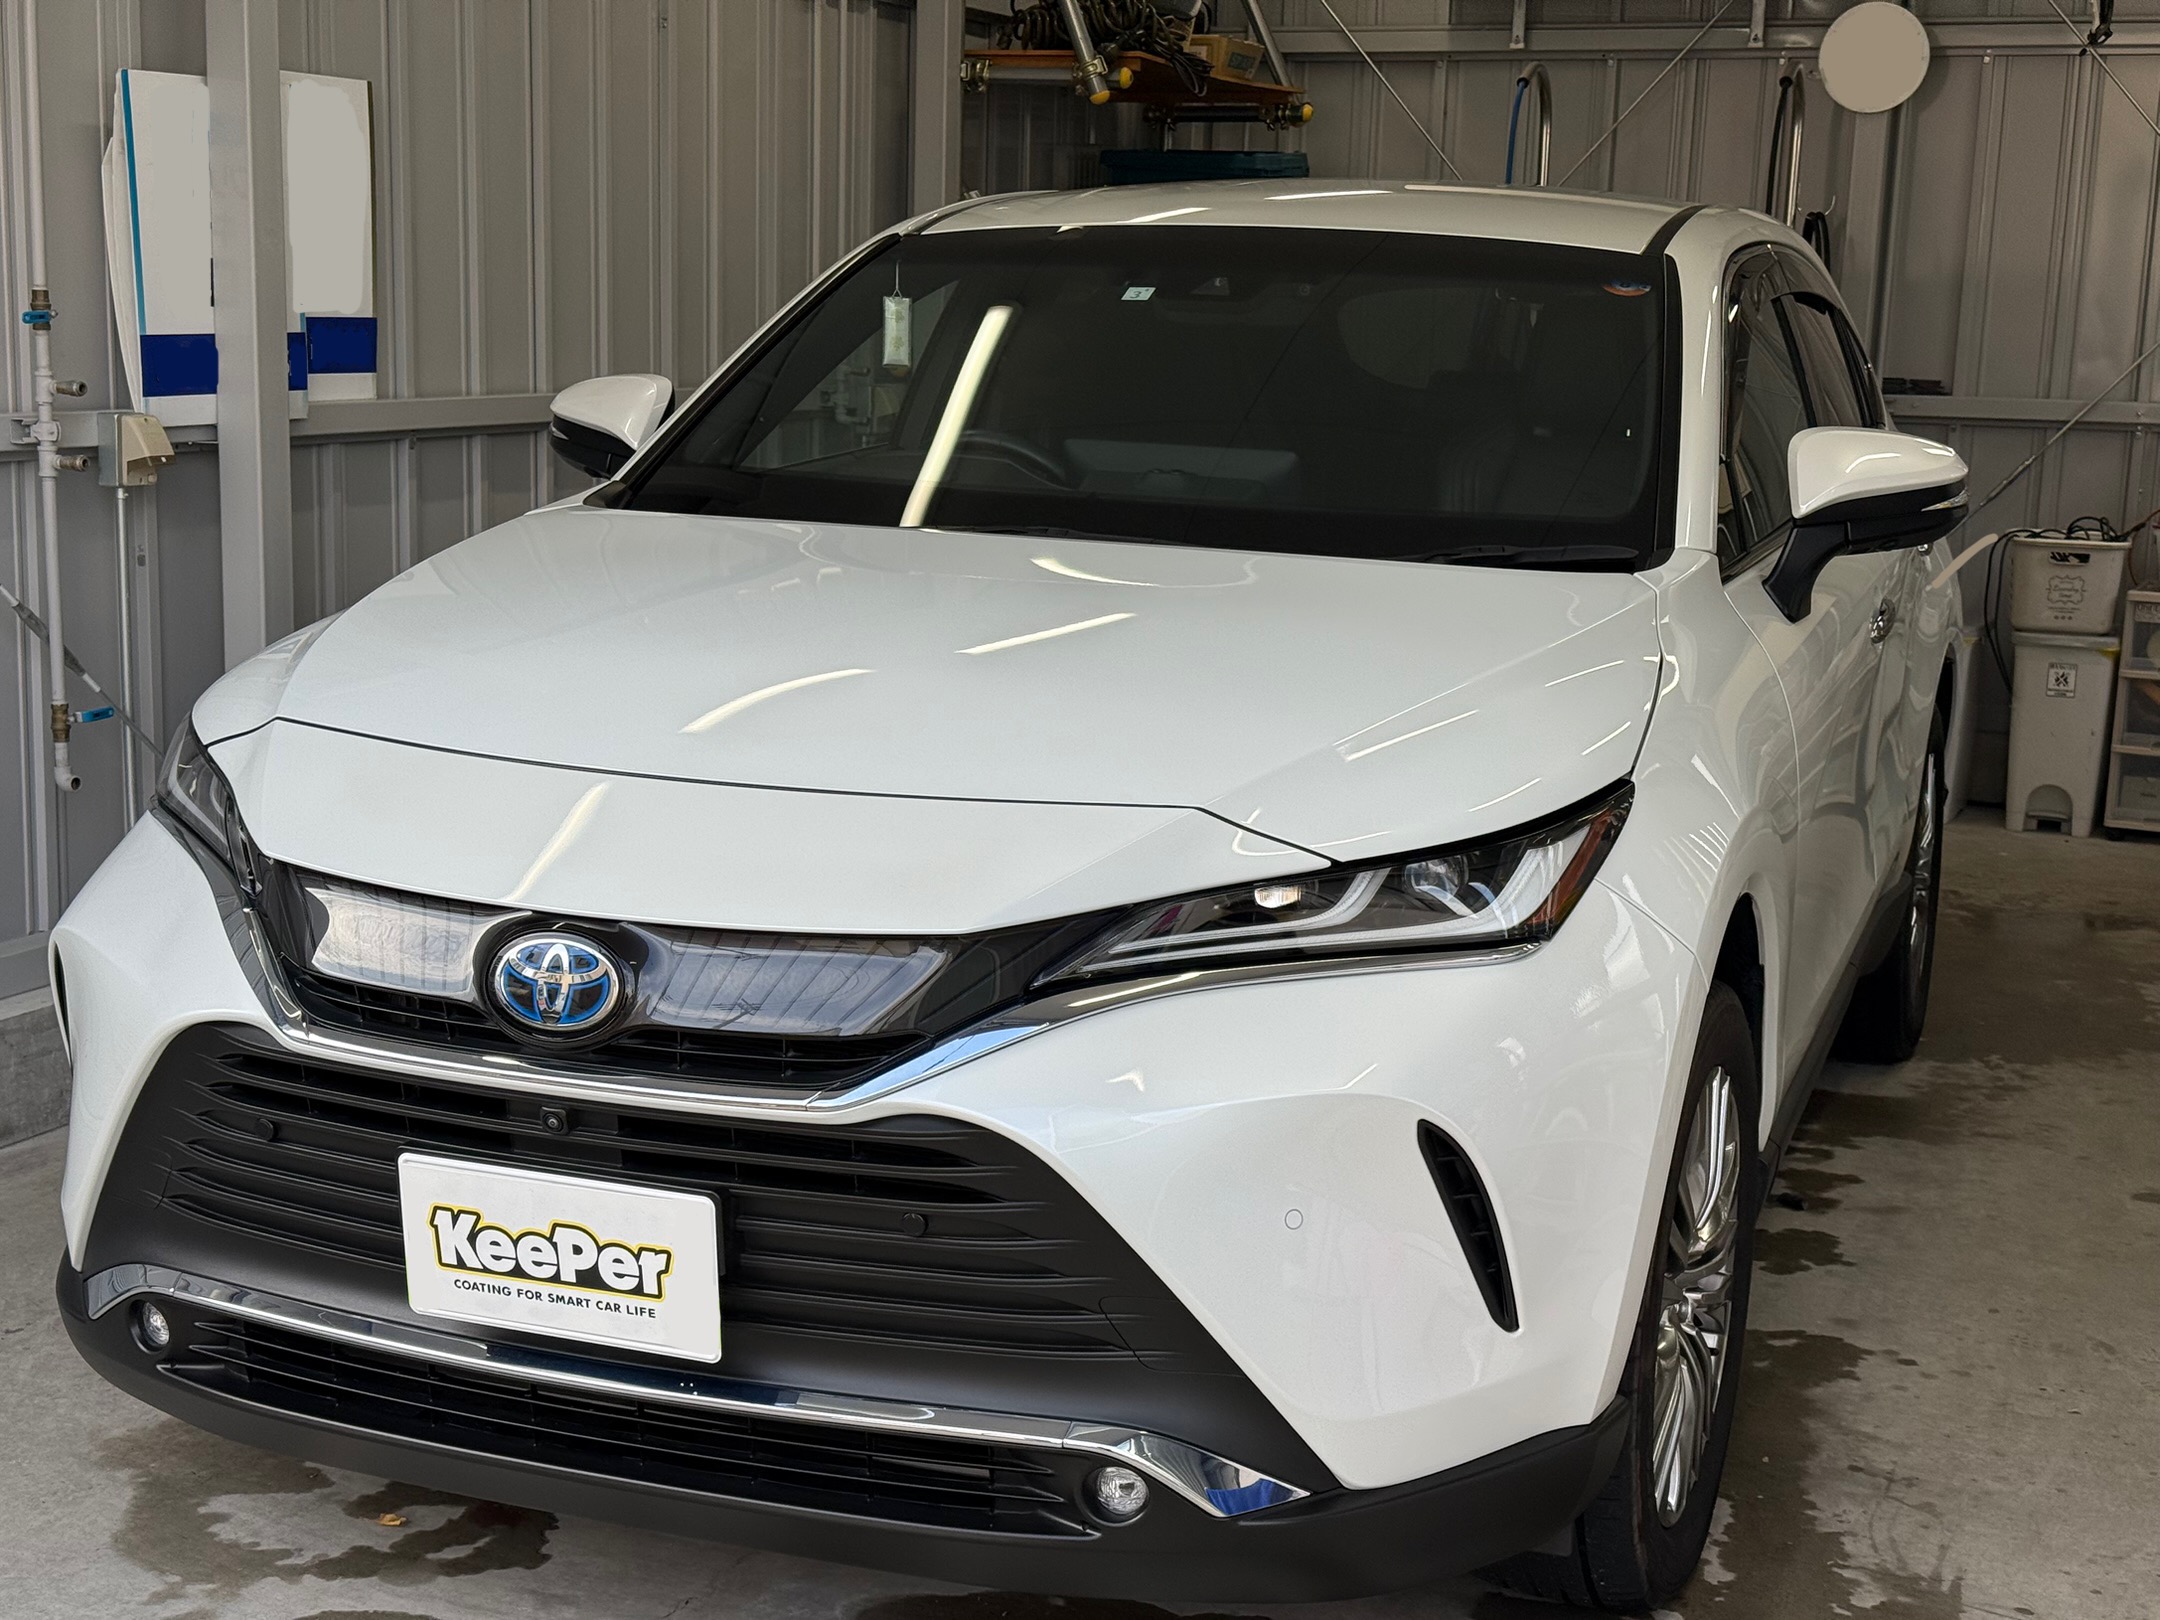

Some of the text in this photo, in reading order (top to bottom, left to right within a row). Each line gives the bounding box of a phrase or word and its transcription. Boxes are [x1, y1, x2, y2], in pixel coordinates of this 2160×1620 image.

[429, 1205, 671, 1299] KeePer
[454, 1279, 656, 1318] COATING FOR SMART CAR LIFE
